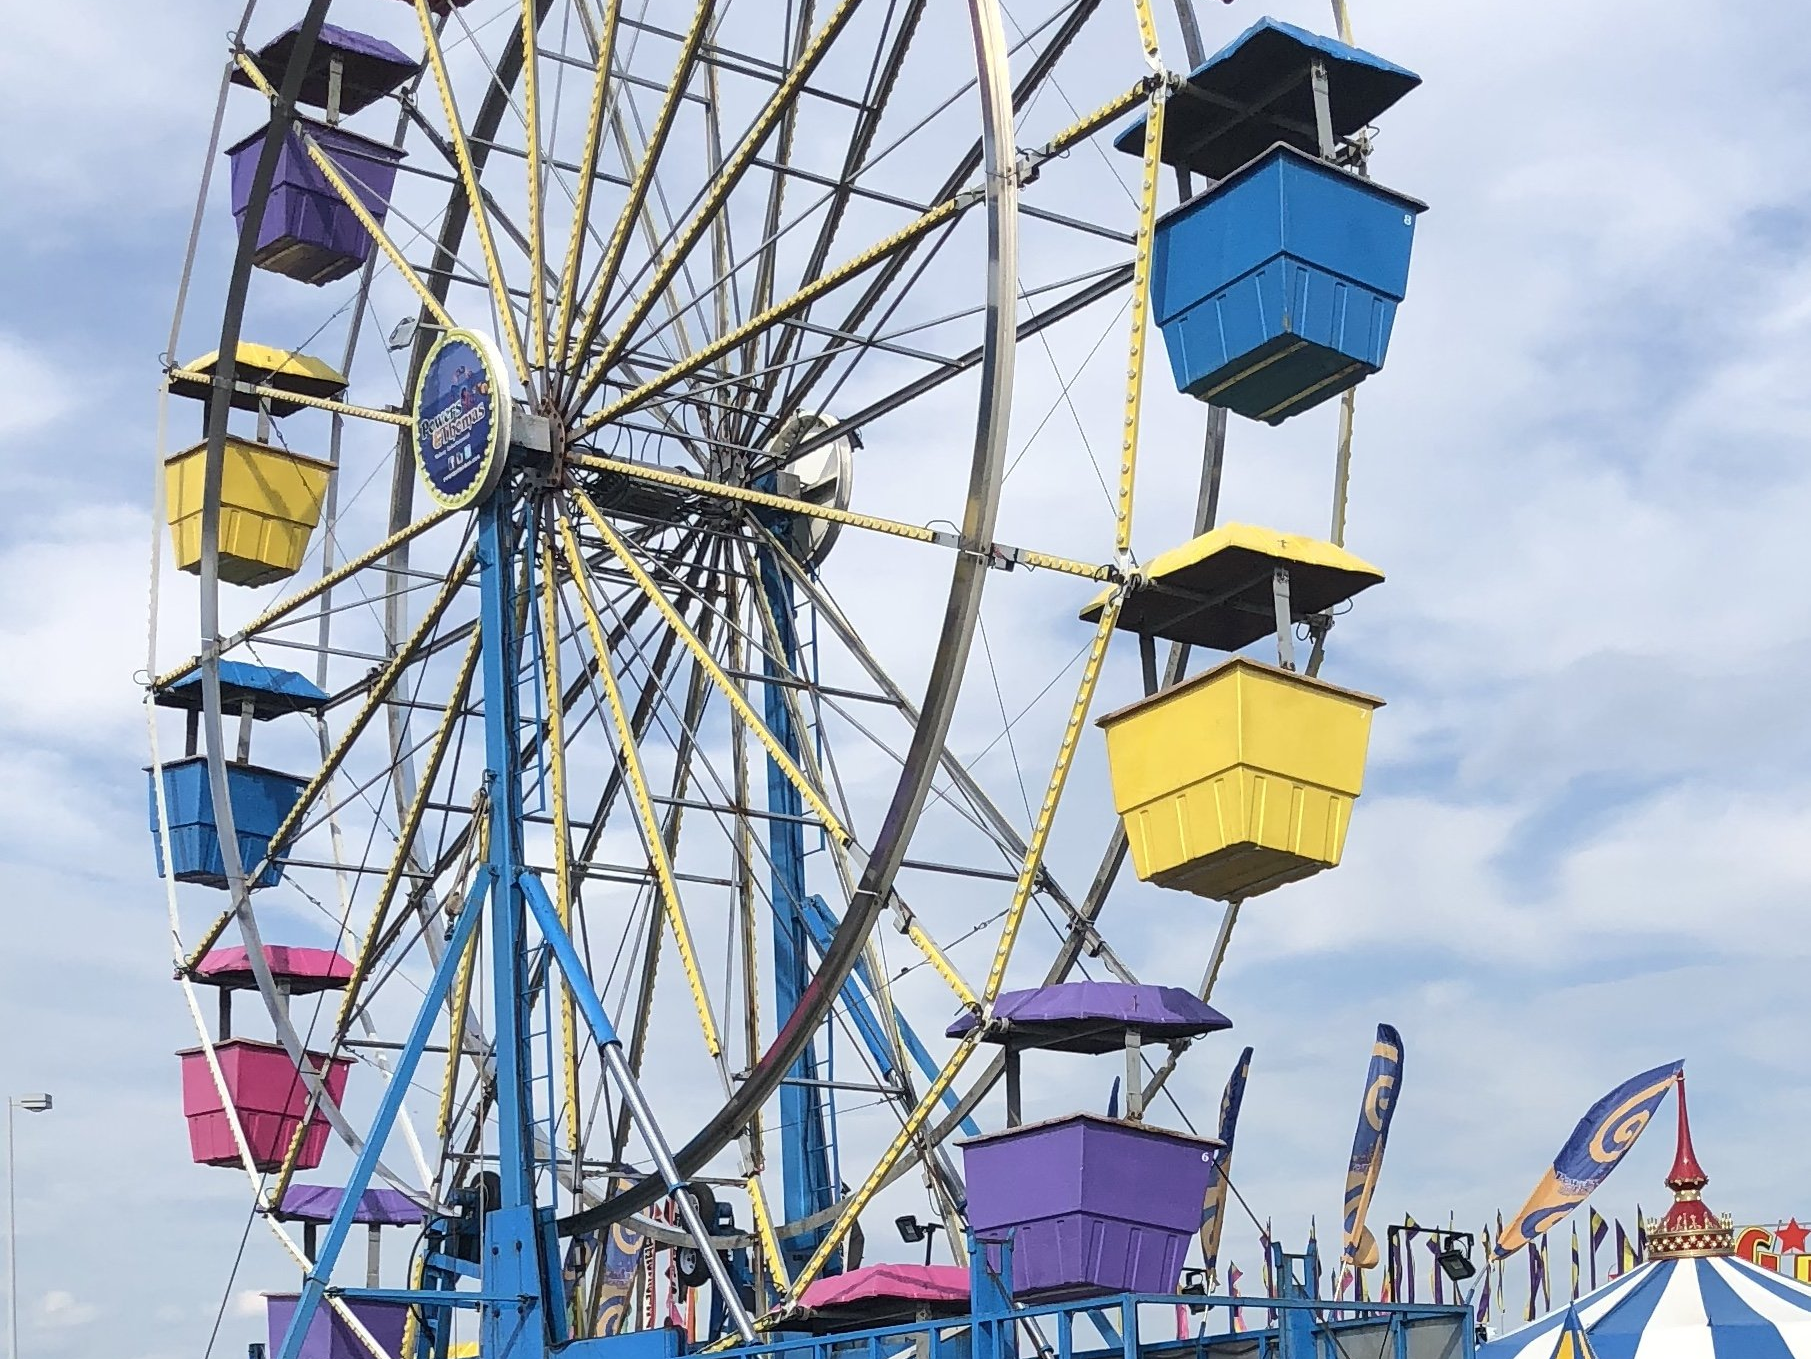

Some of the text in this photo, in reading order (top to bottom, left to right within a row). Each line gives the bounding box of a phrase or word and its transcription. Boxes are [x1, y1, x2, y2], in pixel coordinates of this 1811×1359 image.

[1403, 214, 1412, 226] 8
[421, 399, 462, 440] Powers
[1201, 1152, 1210, 1163] 6
